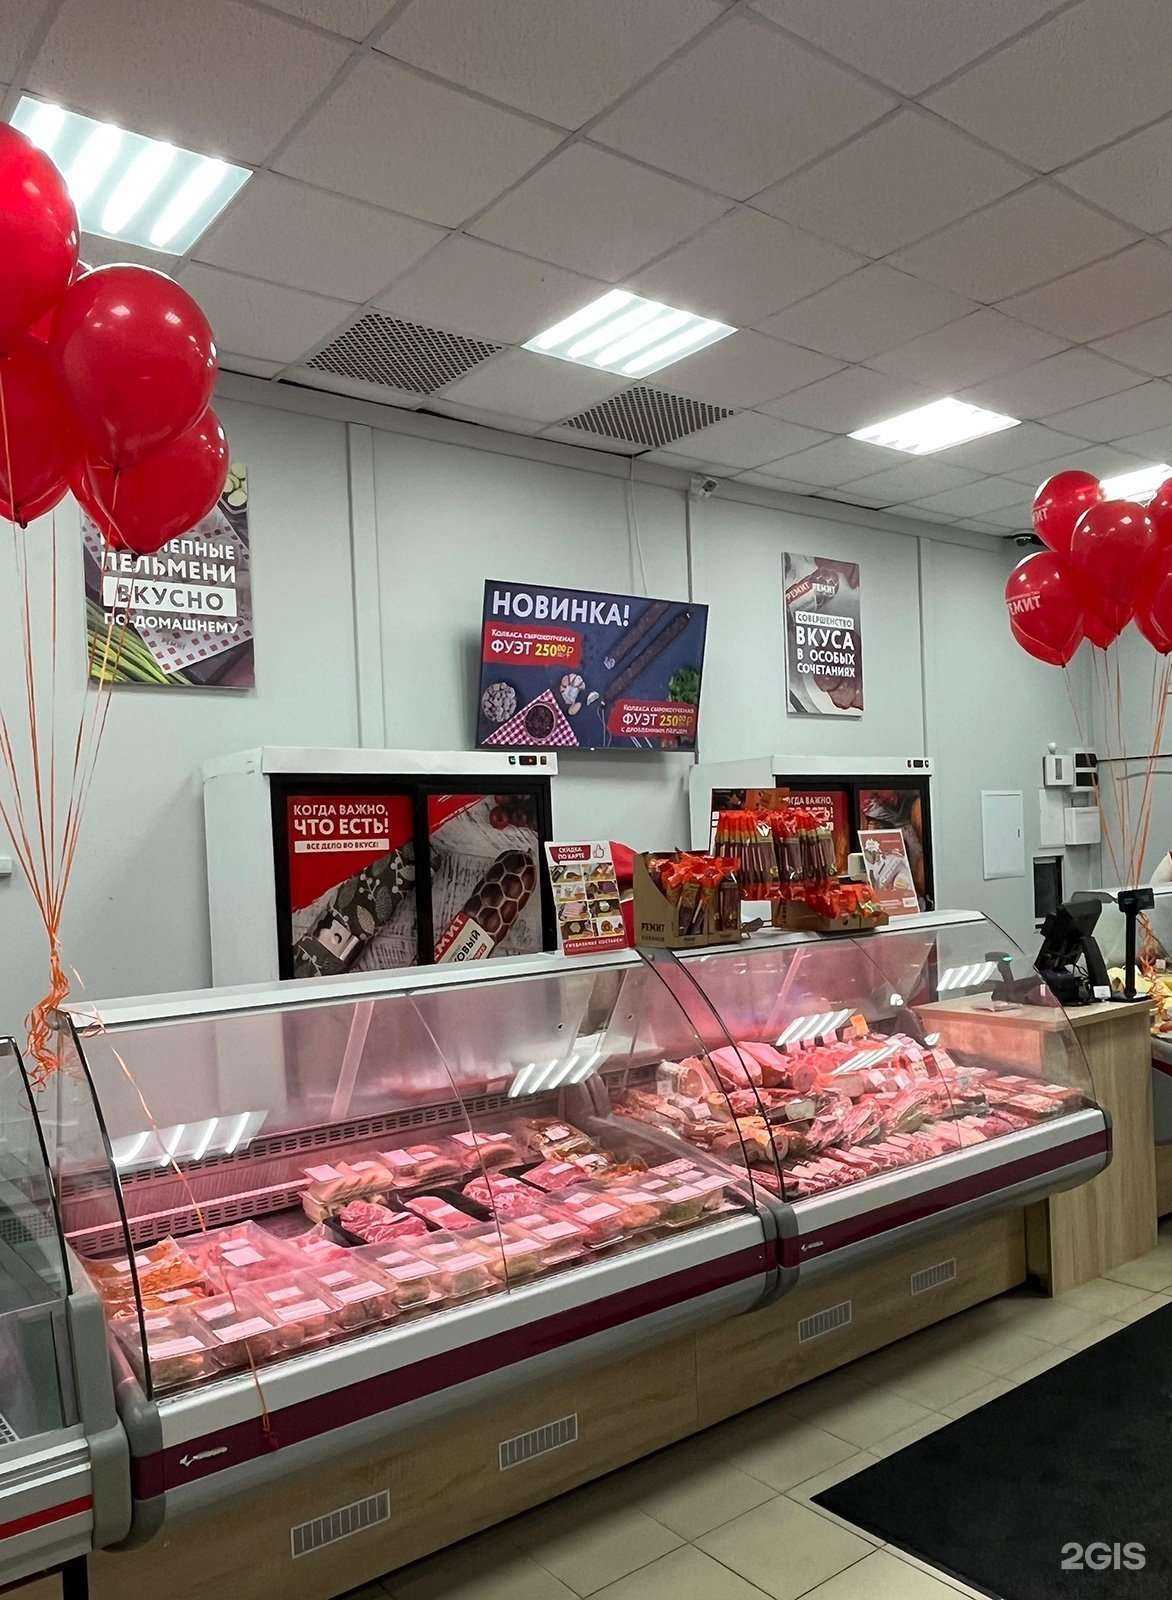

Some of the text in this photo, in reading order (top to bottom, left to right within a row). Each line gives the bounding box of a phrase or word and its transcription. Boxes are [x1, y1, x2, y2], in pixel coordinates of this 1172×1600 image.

[100, 552, 236, 583] ПЕЛЬМЕНИ
[117, 584, 224, 611] ВКУСНО
[492, 590, 630, 627] НОВИНКА!
[797, 613, 854, 628] СОВЕРШЕНСТВО
[795, 625, 855, 651] ВКУСА
[491, 639, 533, 655] ФУЭТ
[797, 648, 856, 665] В ОСОБЫХ
[797, 663, 856, 678] СОЧЕТАНИЯХ
[622, 712, 658, 726] ФУЭТ
[293, 804, 388, 817] КОГДА ВАЖНО,
[294, 817, 389, 836] ЧТО ЕСТЬ!
[321, 842, 342, 850] ДЕЛО
